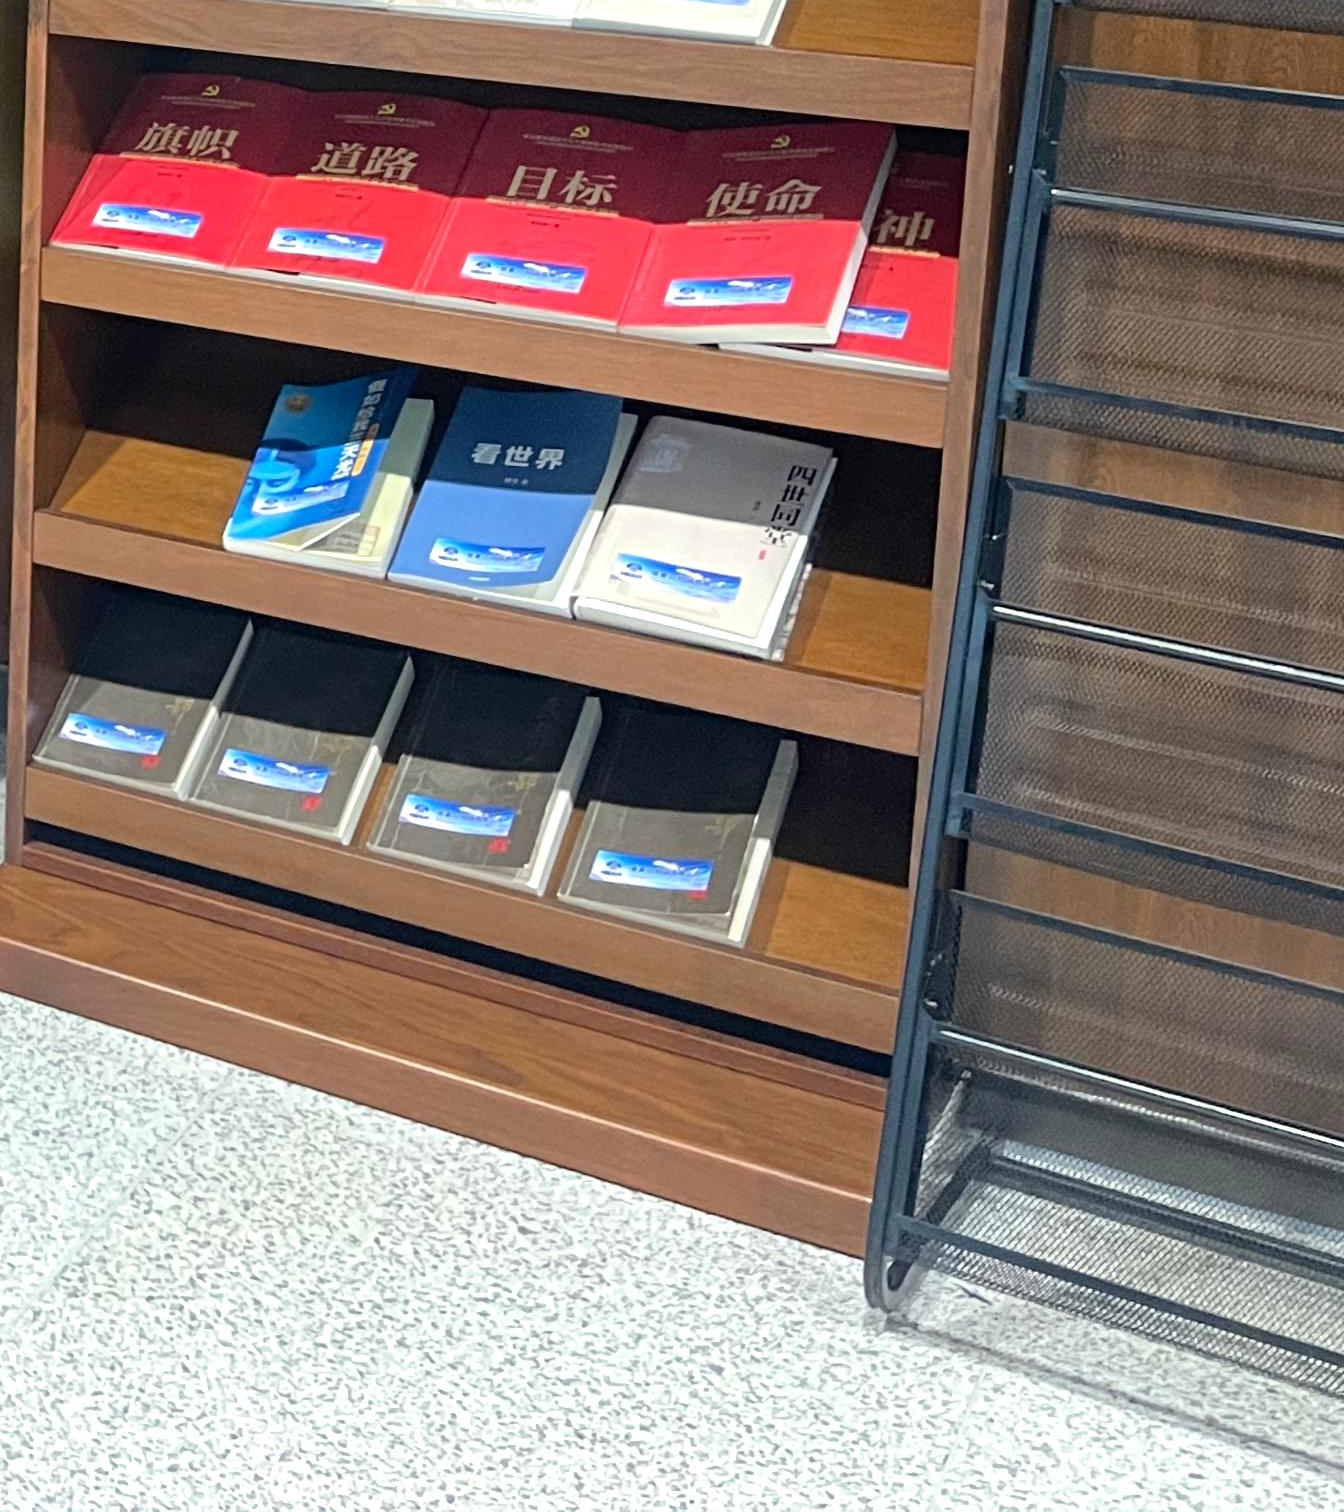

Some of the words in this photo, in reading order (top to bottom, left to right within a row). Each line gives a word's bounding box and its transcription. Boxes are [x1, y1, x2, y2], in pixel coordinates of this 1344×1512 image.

[134, 121, 239, 159] 旗帜
[311, 142, 419, 181] 道路
[506, 165, 618, 206] 目标
[705, 179, 822, 217] 使命
[471, 442, 565, 470] 看世界
